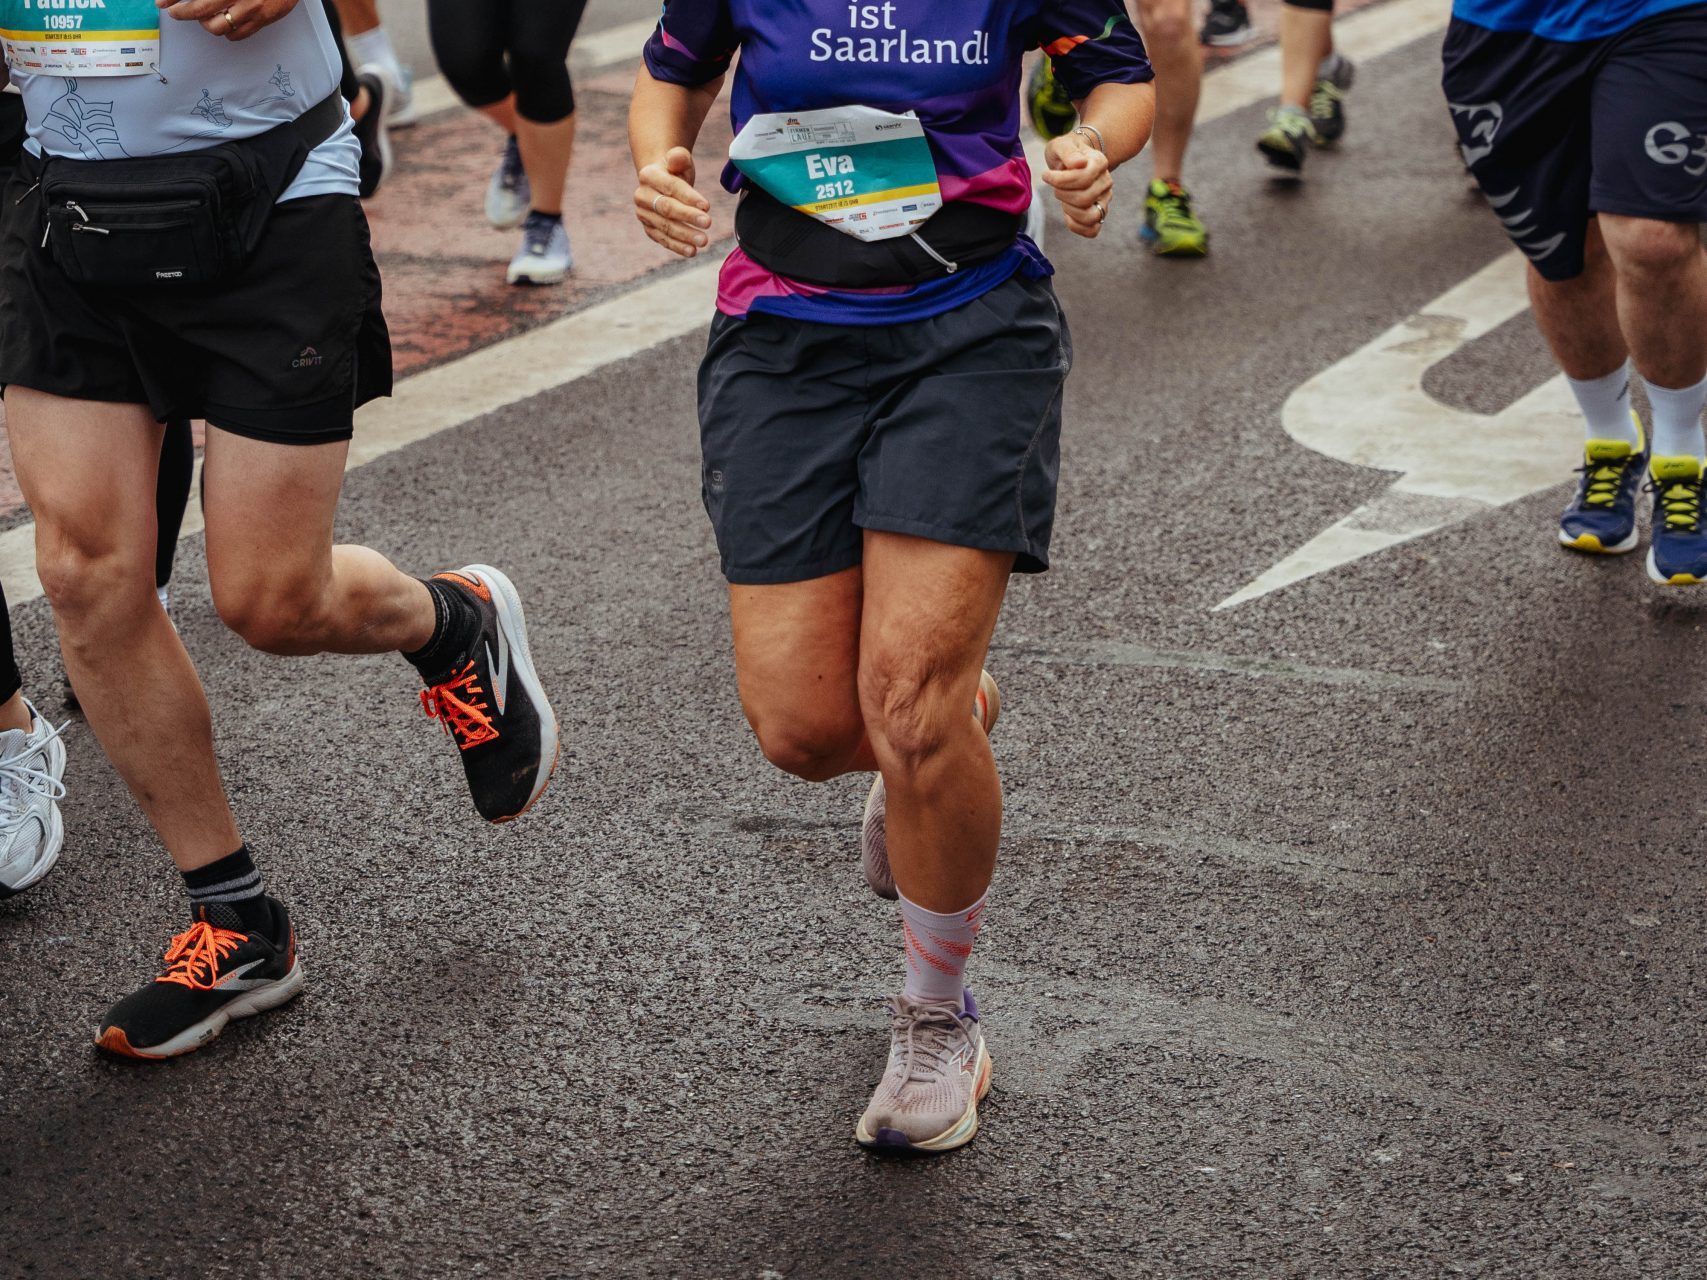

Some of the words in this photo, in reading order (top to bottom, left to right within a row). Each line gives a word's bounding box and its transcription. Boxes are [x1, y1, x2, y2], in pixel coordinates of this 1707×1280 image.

[43, 14, 83, 30] 10957
[809, 28, 990, 65] Saarland!
[805, 153, 855, 180] Eva
[815, 180, 855, 200] 2512
[292, 356, 322, 368] CRIVIT
